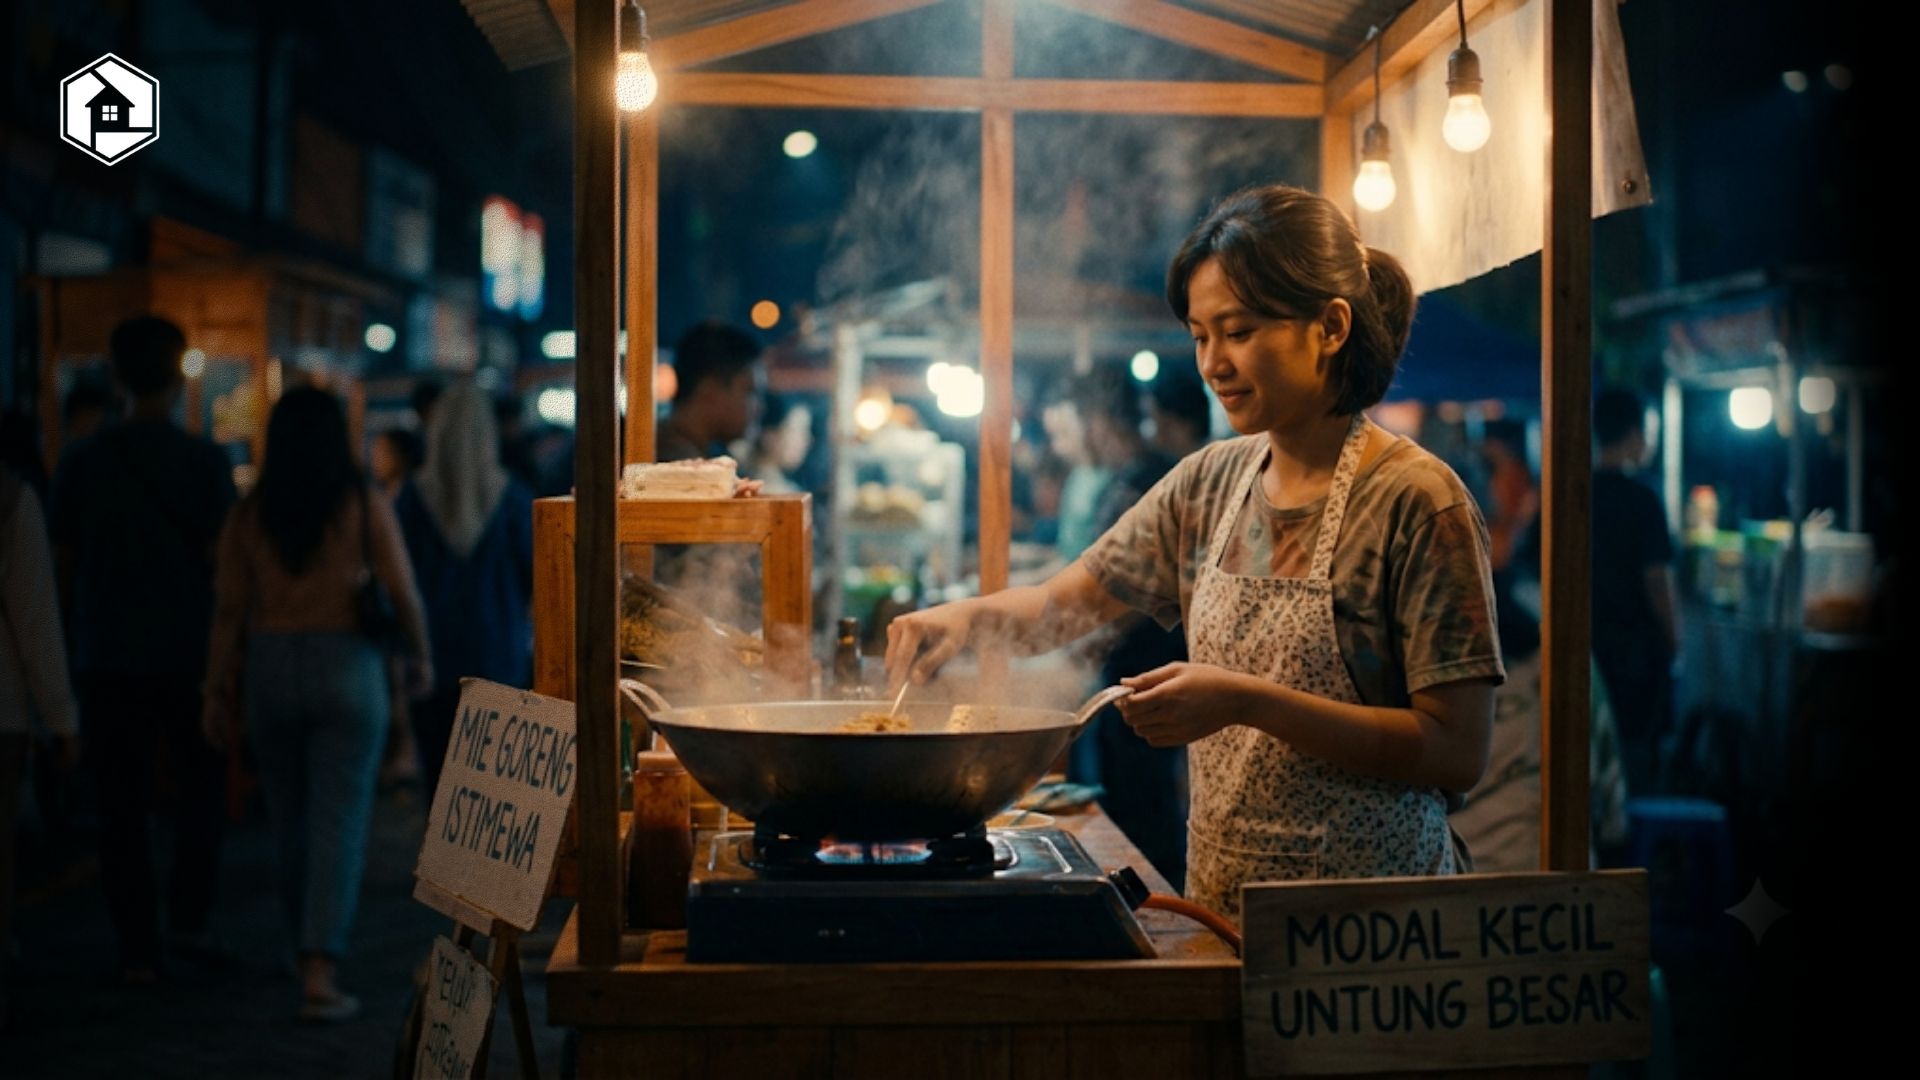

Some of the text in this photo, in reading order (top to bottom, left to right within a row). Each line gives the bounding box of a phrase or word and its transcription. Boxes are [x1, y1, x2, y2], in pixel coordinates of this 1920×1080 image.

[453, 706, 577, 797] MIE GORENG
[442, 786, 540, 873] ISTIMEWA
[1287, 903, 1614, 967] MODAL KECIL
[1272, 980, 1467, 1039] UNTUNG
